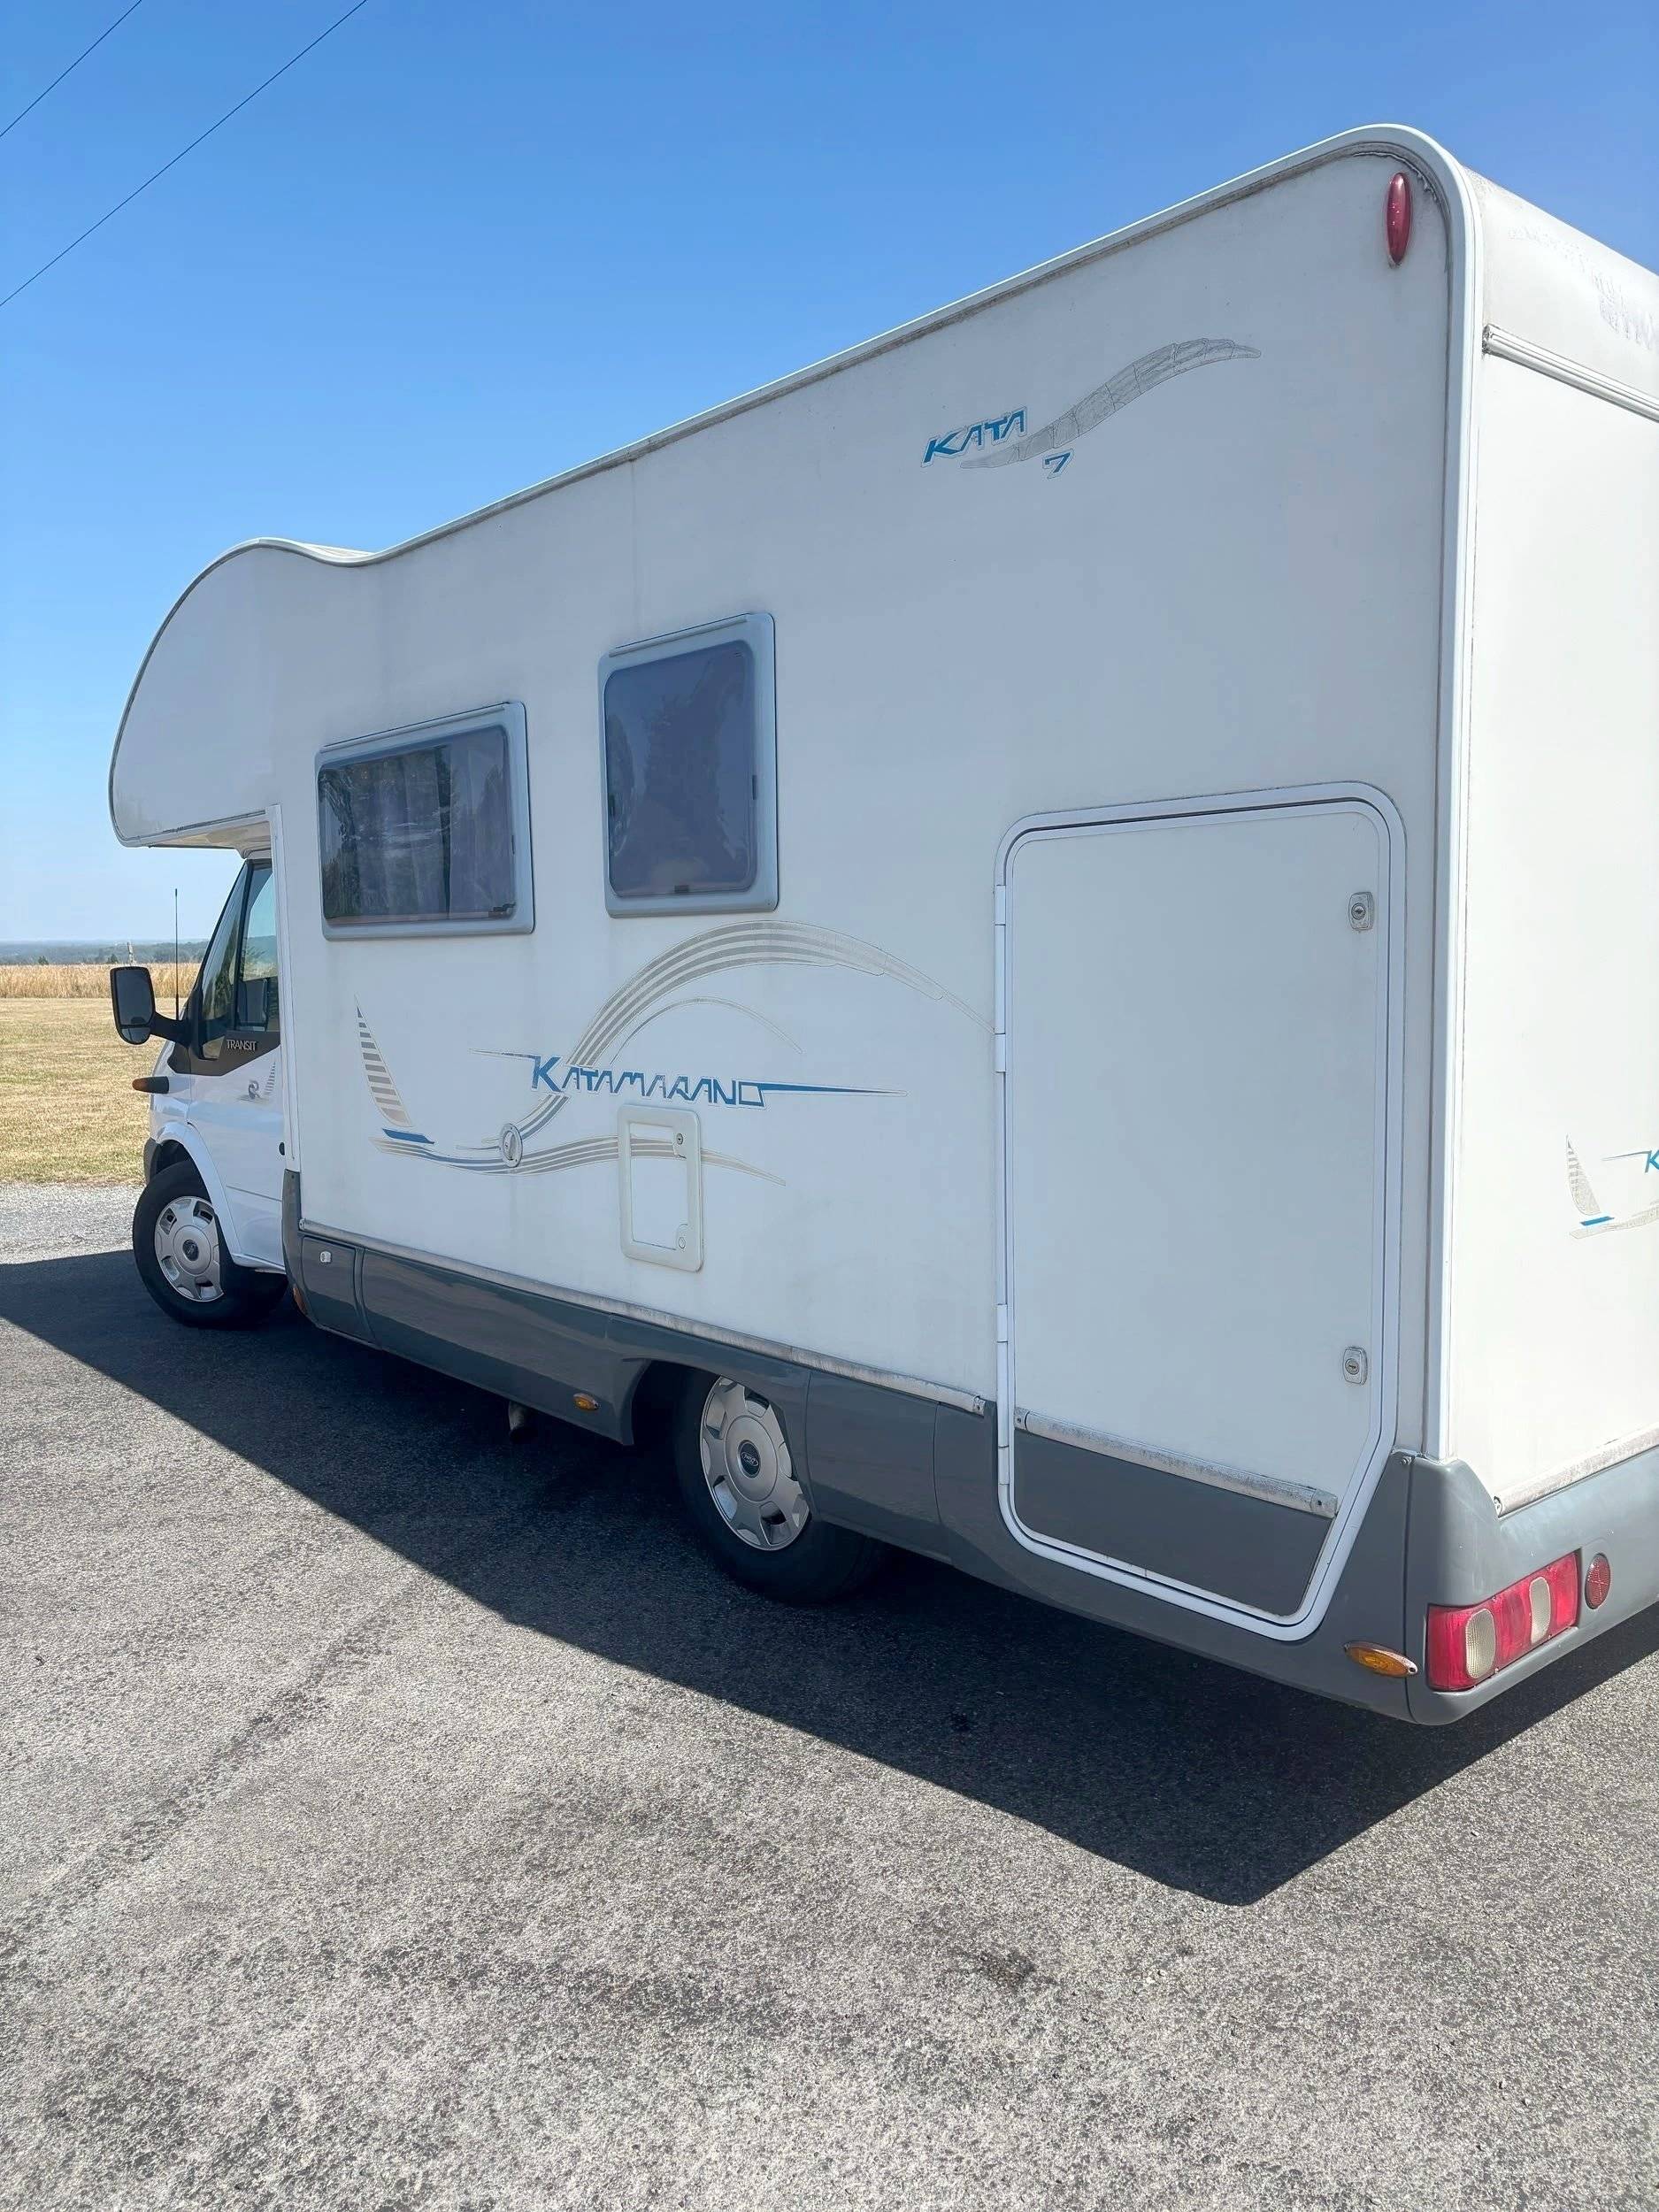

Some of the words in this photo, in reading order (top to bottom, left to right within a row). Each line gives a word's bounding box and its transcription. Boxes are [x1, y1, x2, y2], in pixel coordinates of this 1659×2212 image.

[922, 409, 1025, 465] KATA
[1043, 450, 1072, 475] 7
[227, 1039, 257, 1051] TRANSIT
